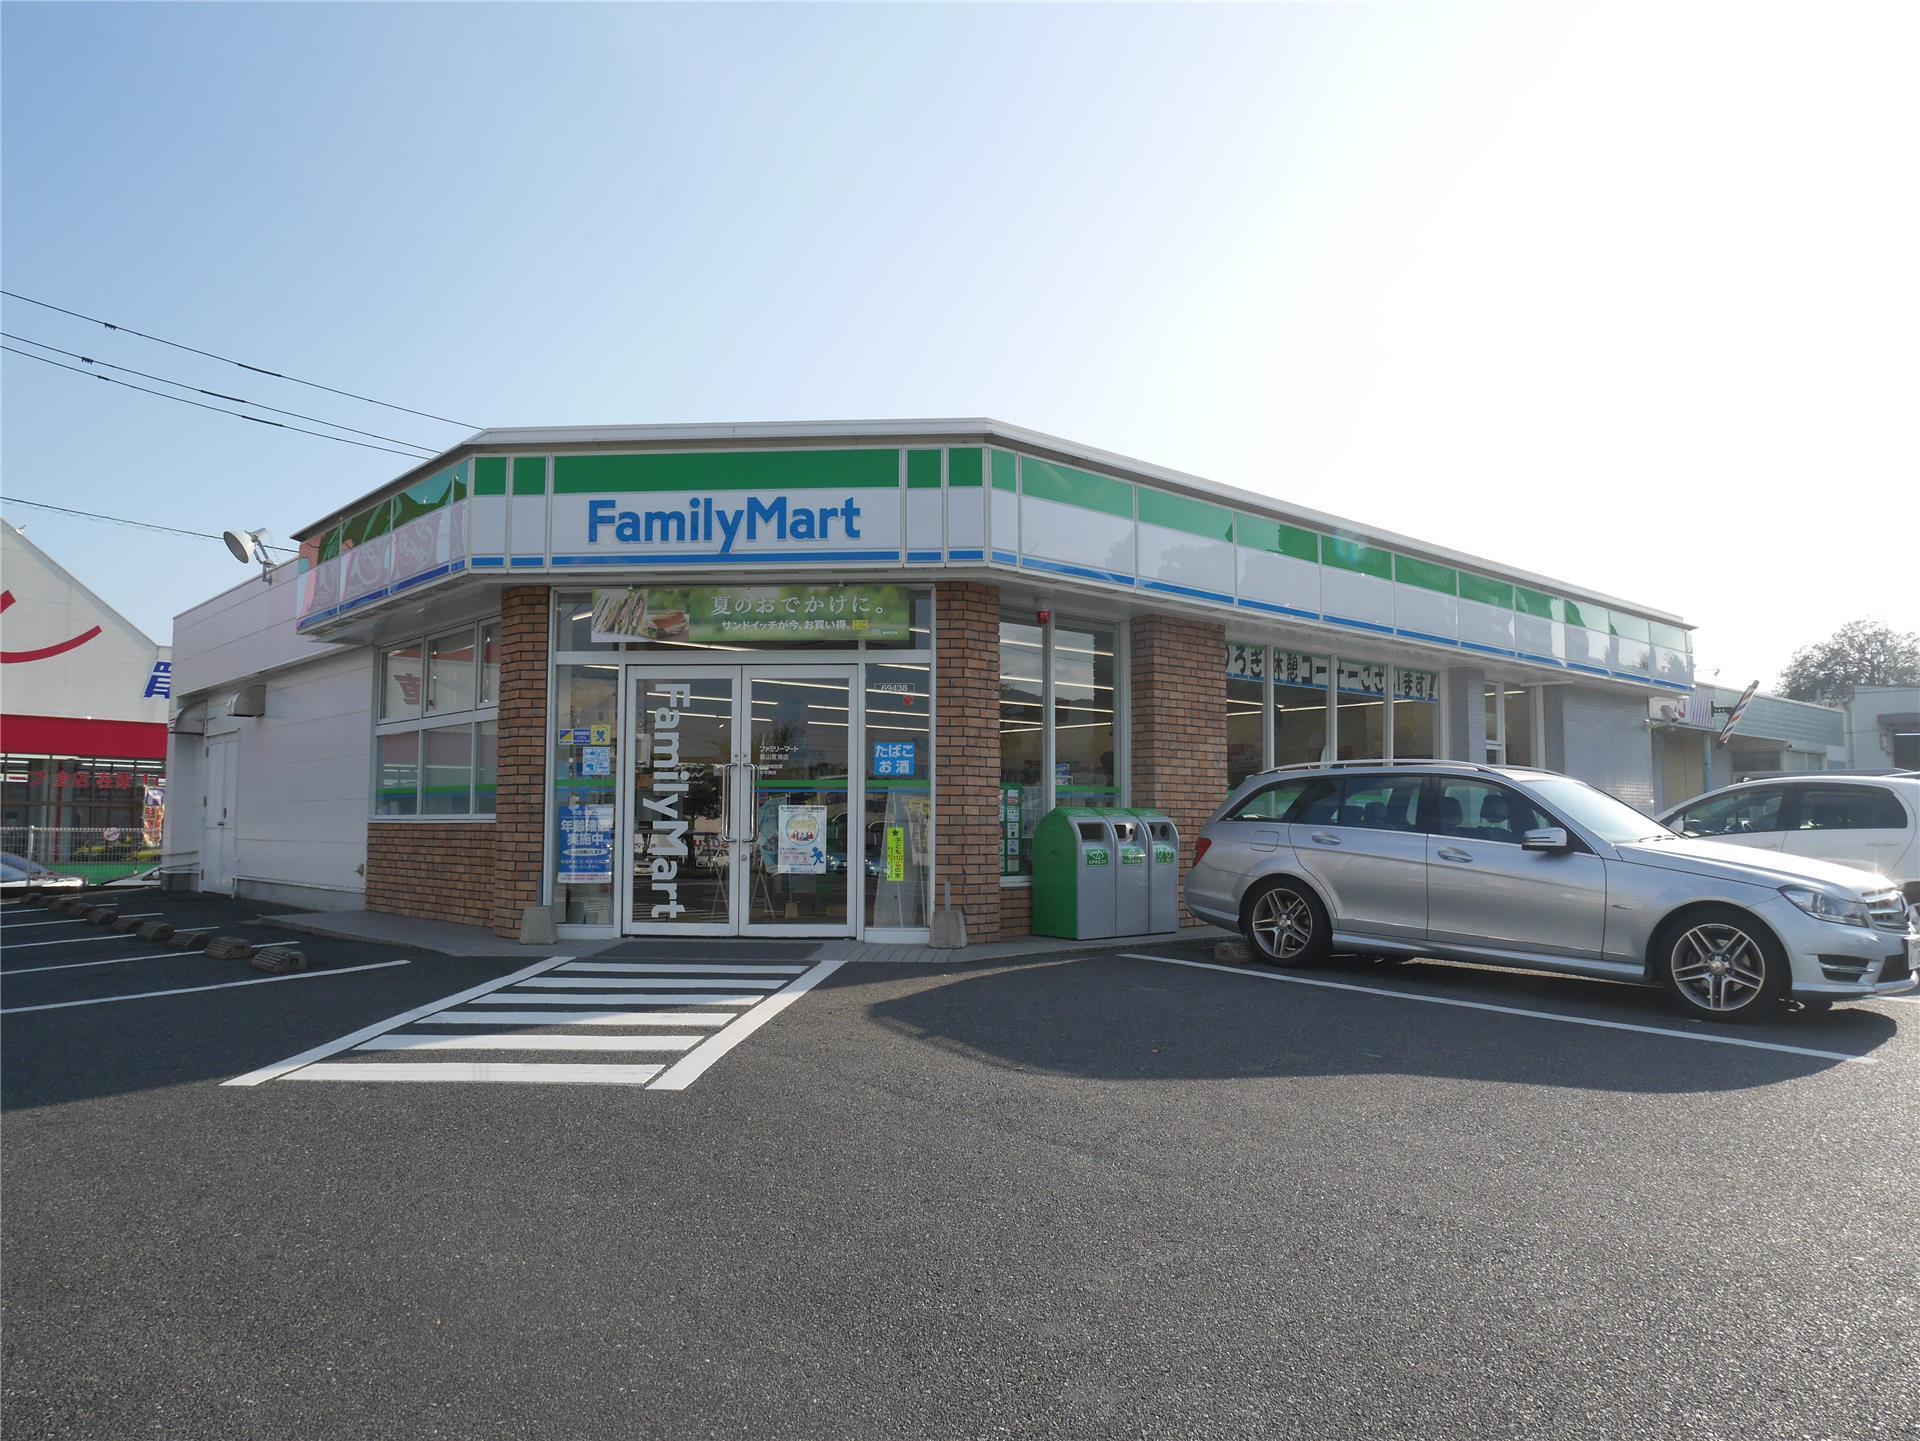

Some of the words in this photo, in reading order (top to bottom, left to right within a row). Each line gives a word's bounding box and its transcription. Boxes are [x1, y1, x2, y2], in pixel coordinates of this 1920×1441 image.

[588, 497, 861, 553] FamilyMart
[711, 596, 883, 616] 夏のおでかけに。
[760, 745, 800, 753] ファミリーマート
[875, 744, 914, 757] たばこ
[879, 760, 910, 773] お酒
[643, 683, 691, 919] FamilyMart
